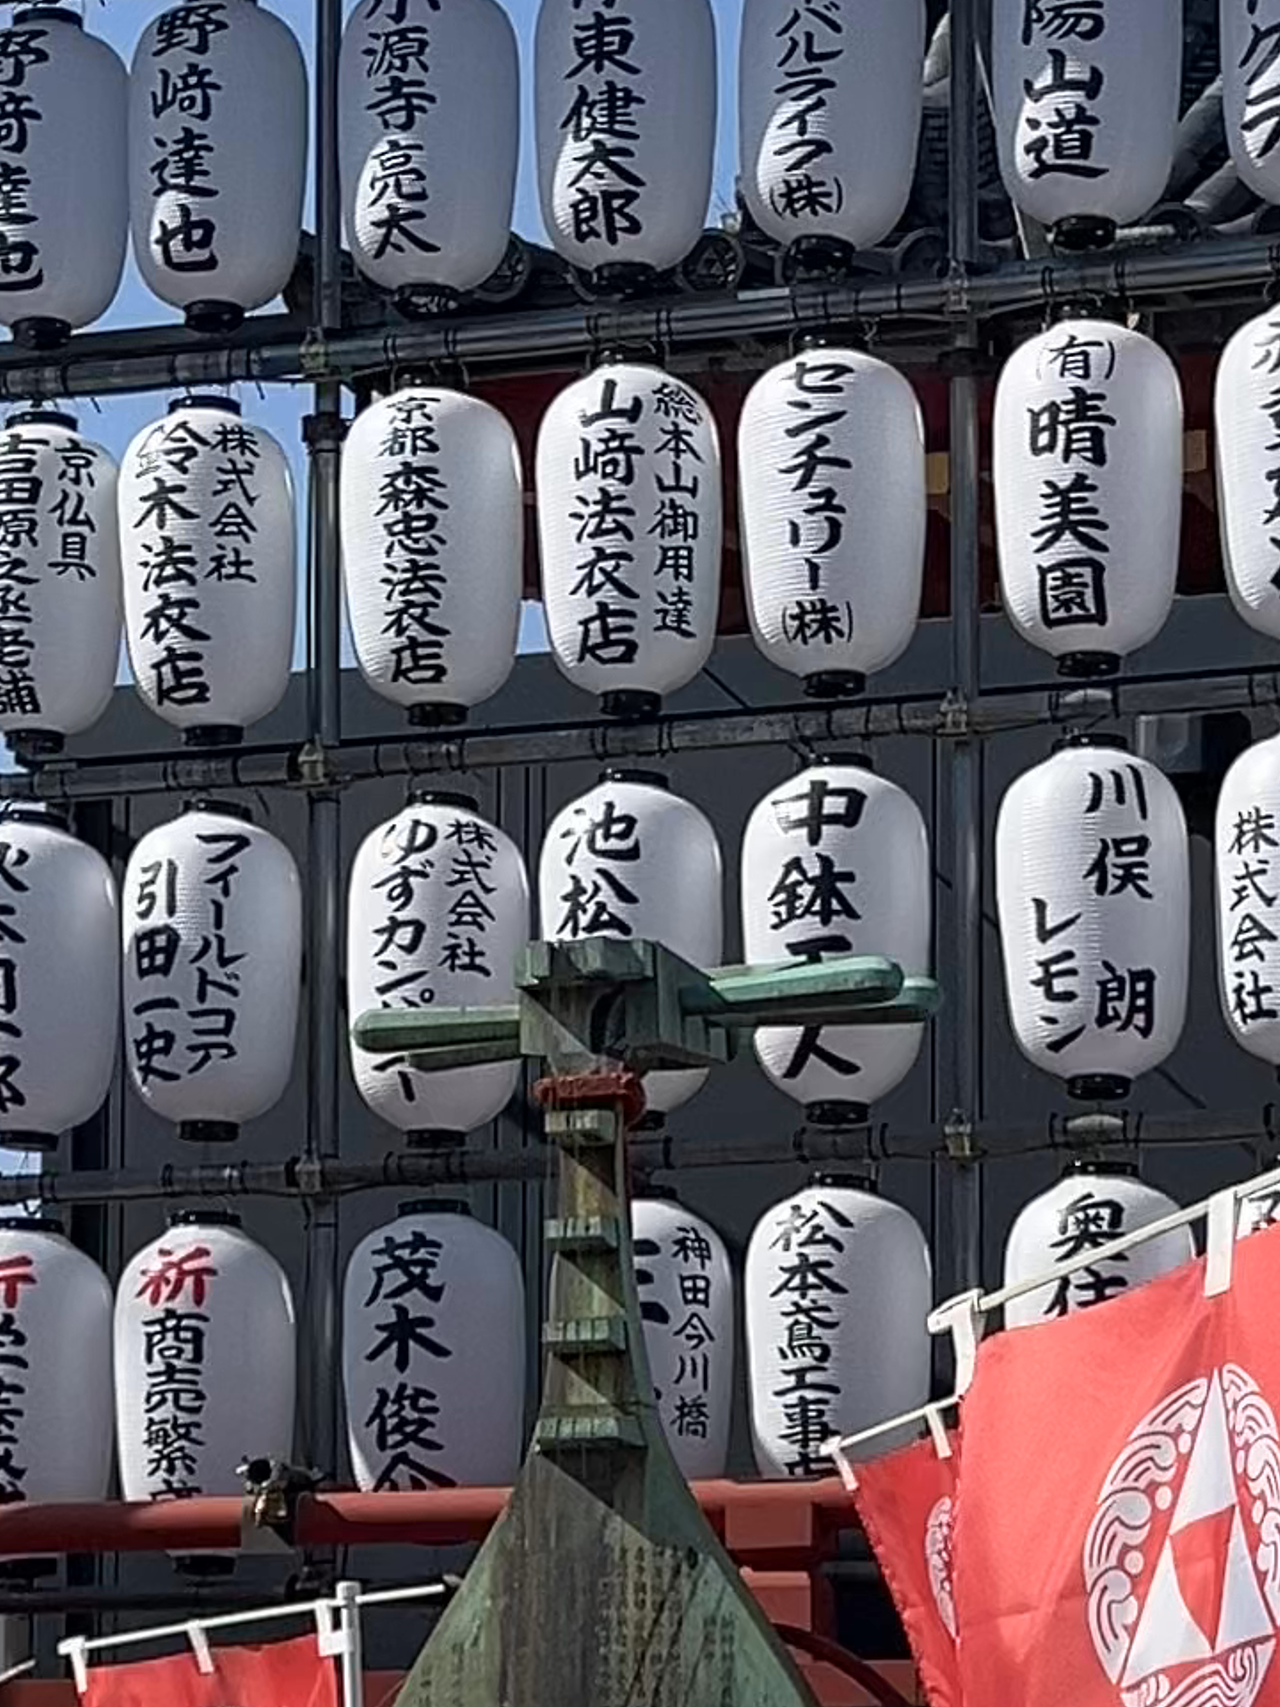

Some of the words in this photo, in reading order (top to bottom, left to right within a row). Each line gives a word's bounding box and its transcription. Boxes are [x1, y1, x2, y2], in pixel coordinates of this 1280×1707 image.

[48, 438, 98, 581] 京仏具
[133, 419, 212, 707] 鈴木法衣店
[204, 424, 261, 584] 株式会社
[647, 382, 705, 640] 総本山御用達
[777, 361, 856, 646] センチュリー(株)
[132, 859, 181, 1086] 引田一史
[186, 832, 252, 1075] フィールドコア
[439, 819, 499, 978] 株式会社
[766, 779, 869, 1081] 中鉢人
[1030, 898, 1087, 1054] レモン
[1228, 806, 1279, 1026] 株式会社
[670, 1226, 714, 1440] 神田今川橋
